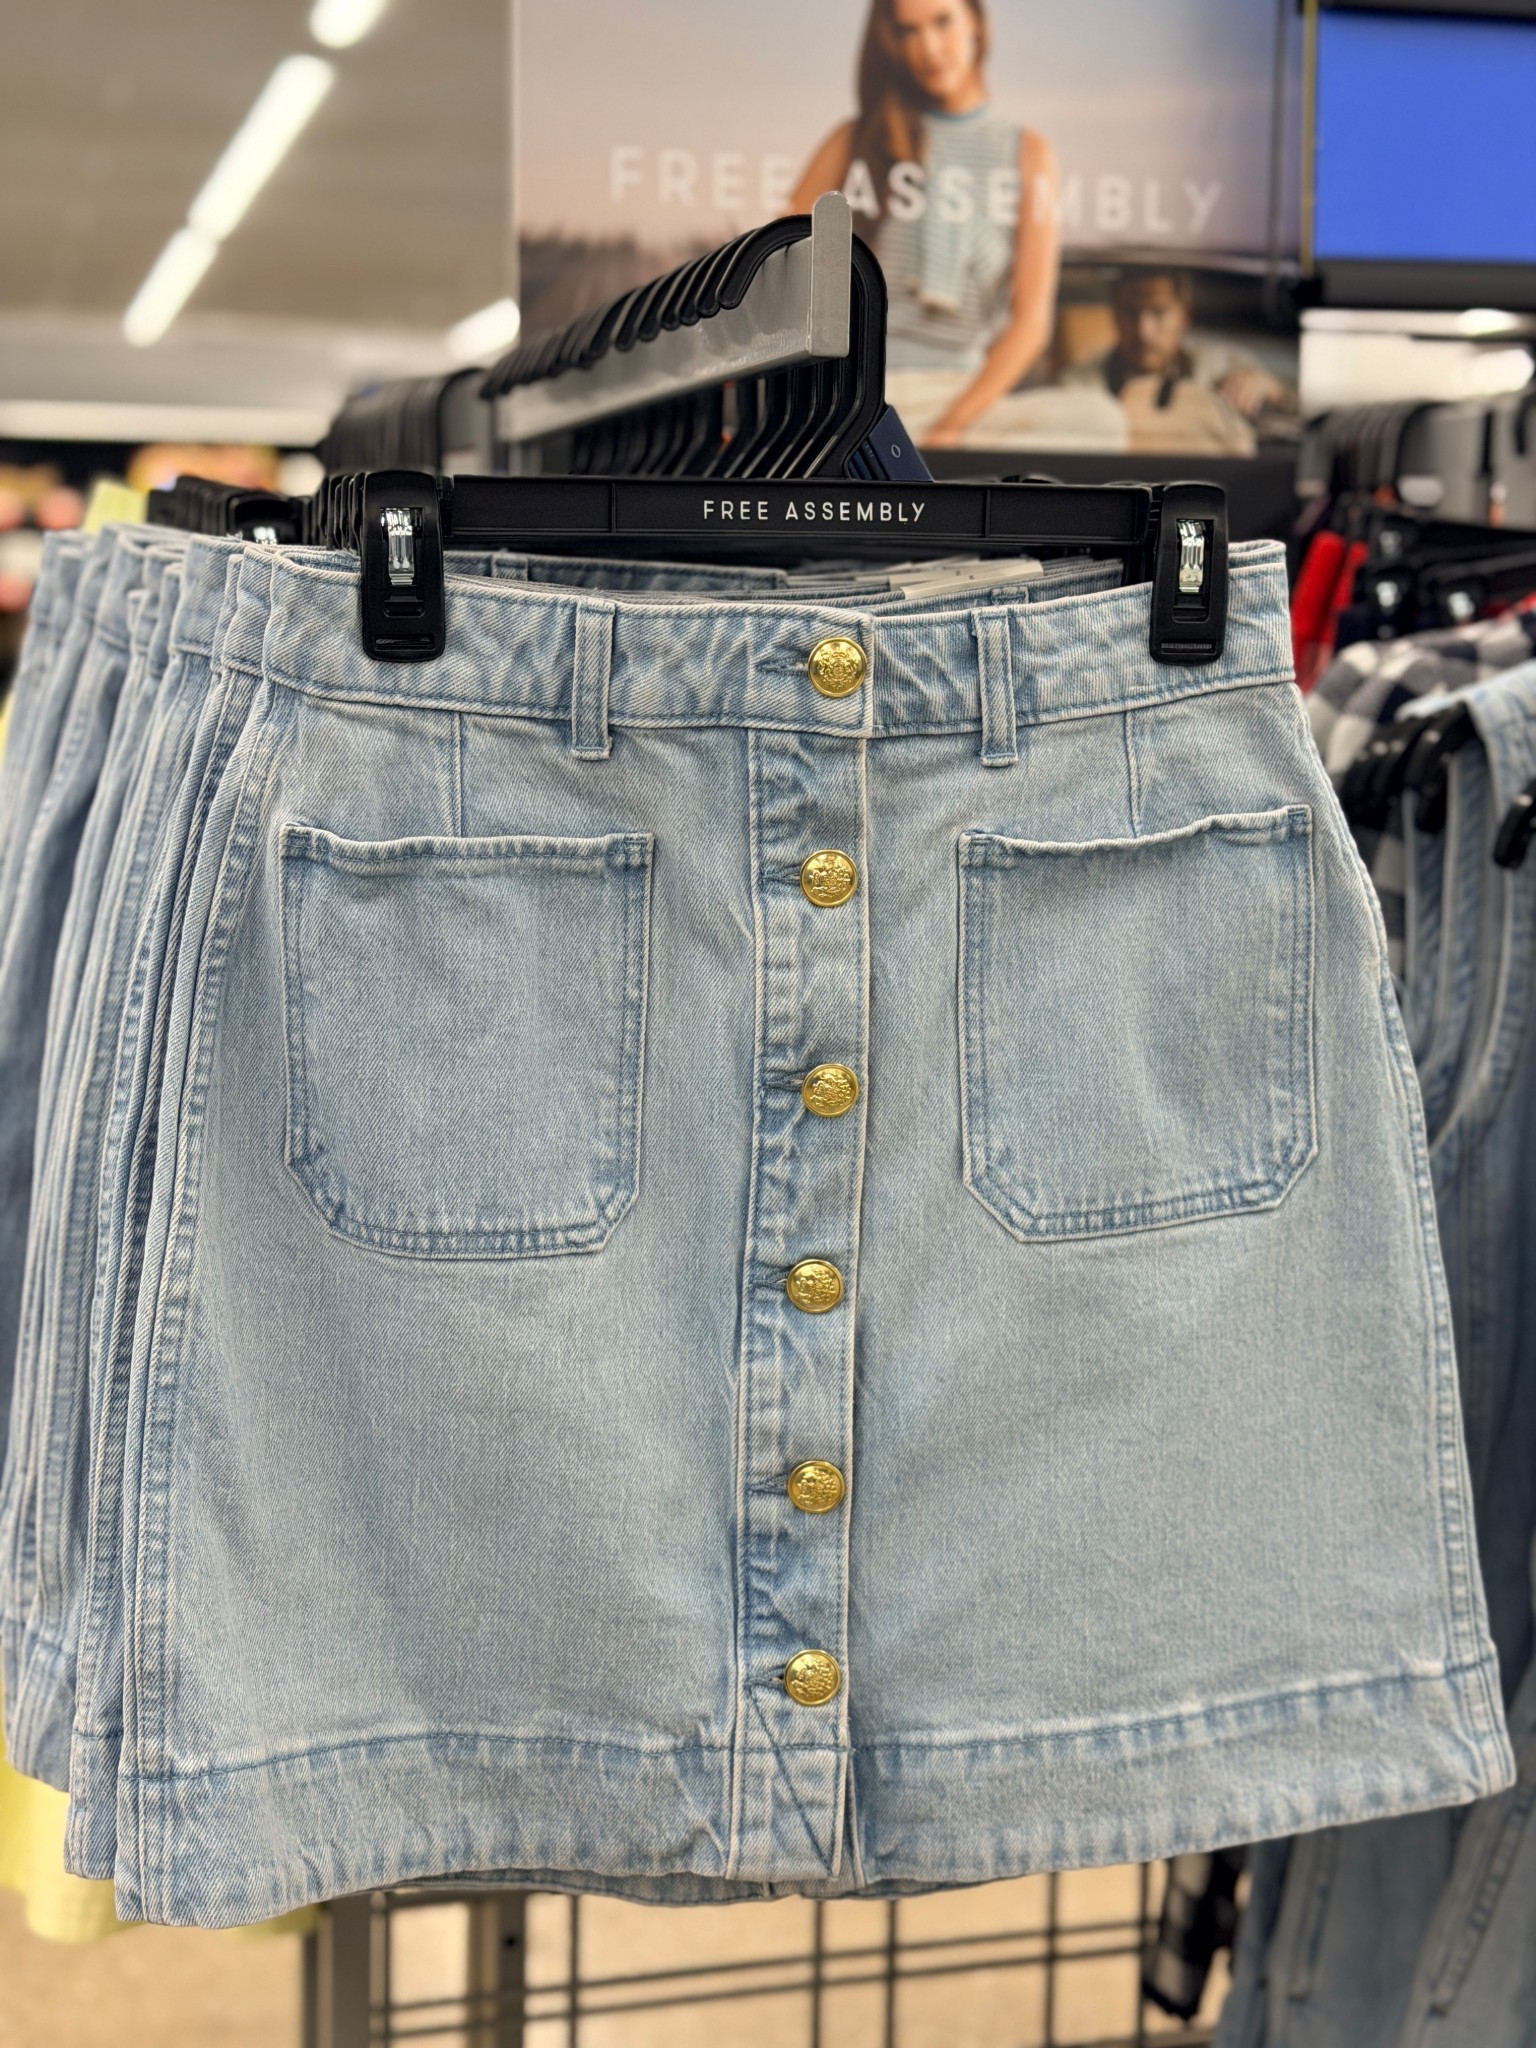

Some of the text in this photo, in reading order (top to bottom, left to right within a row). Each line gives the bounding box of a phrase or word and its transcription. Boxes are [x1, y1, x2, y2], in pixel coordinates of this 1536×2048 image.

[609, 144, 1223, 235] FREE ASSEMBLY
[703, 500, 925, 522] FREE ASSEMBLY
